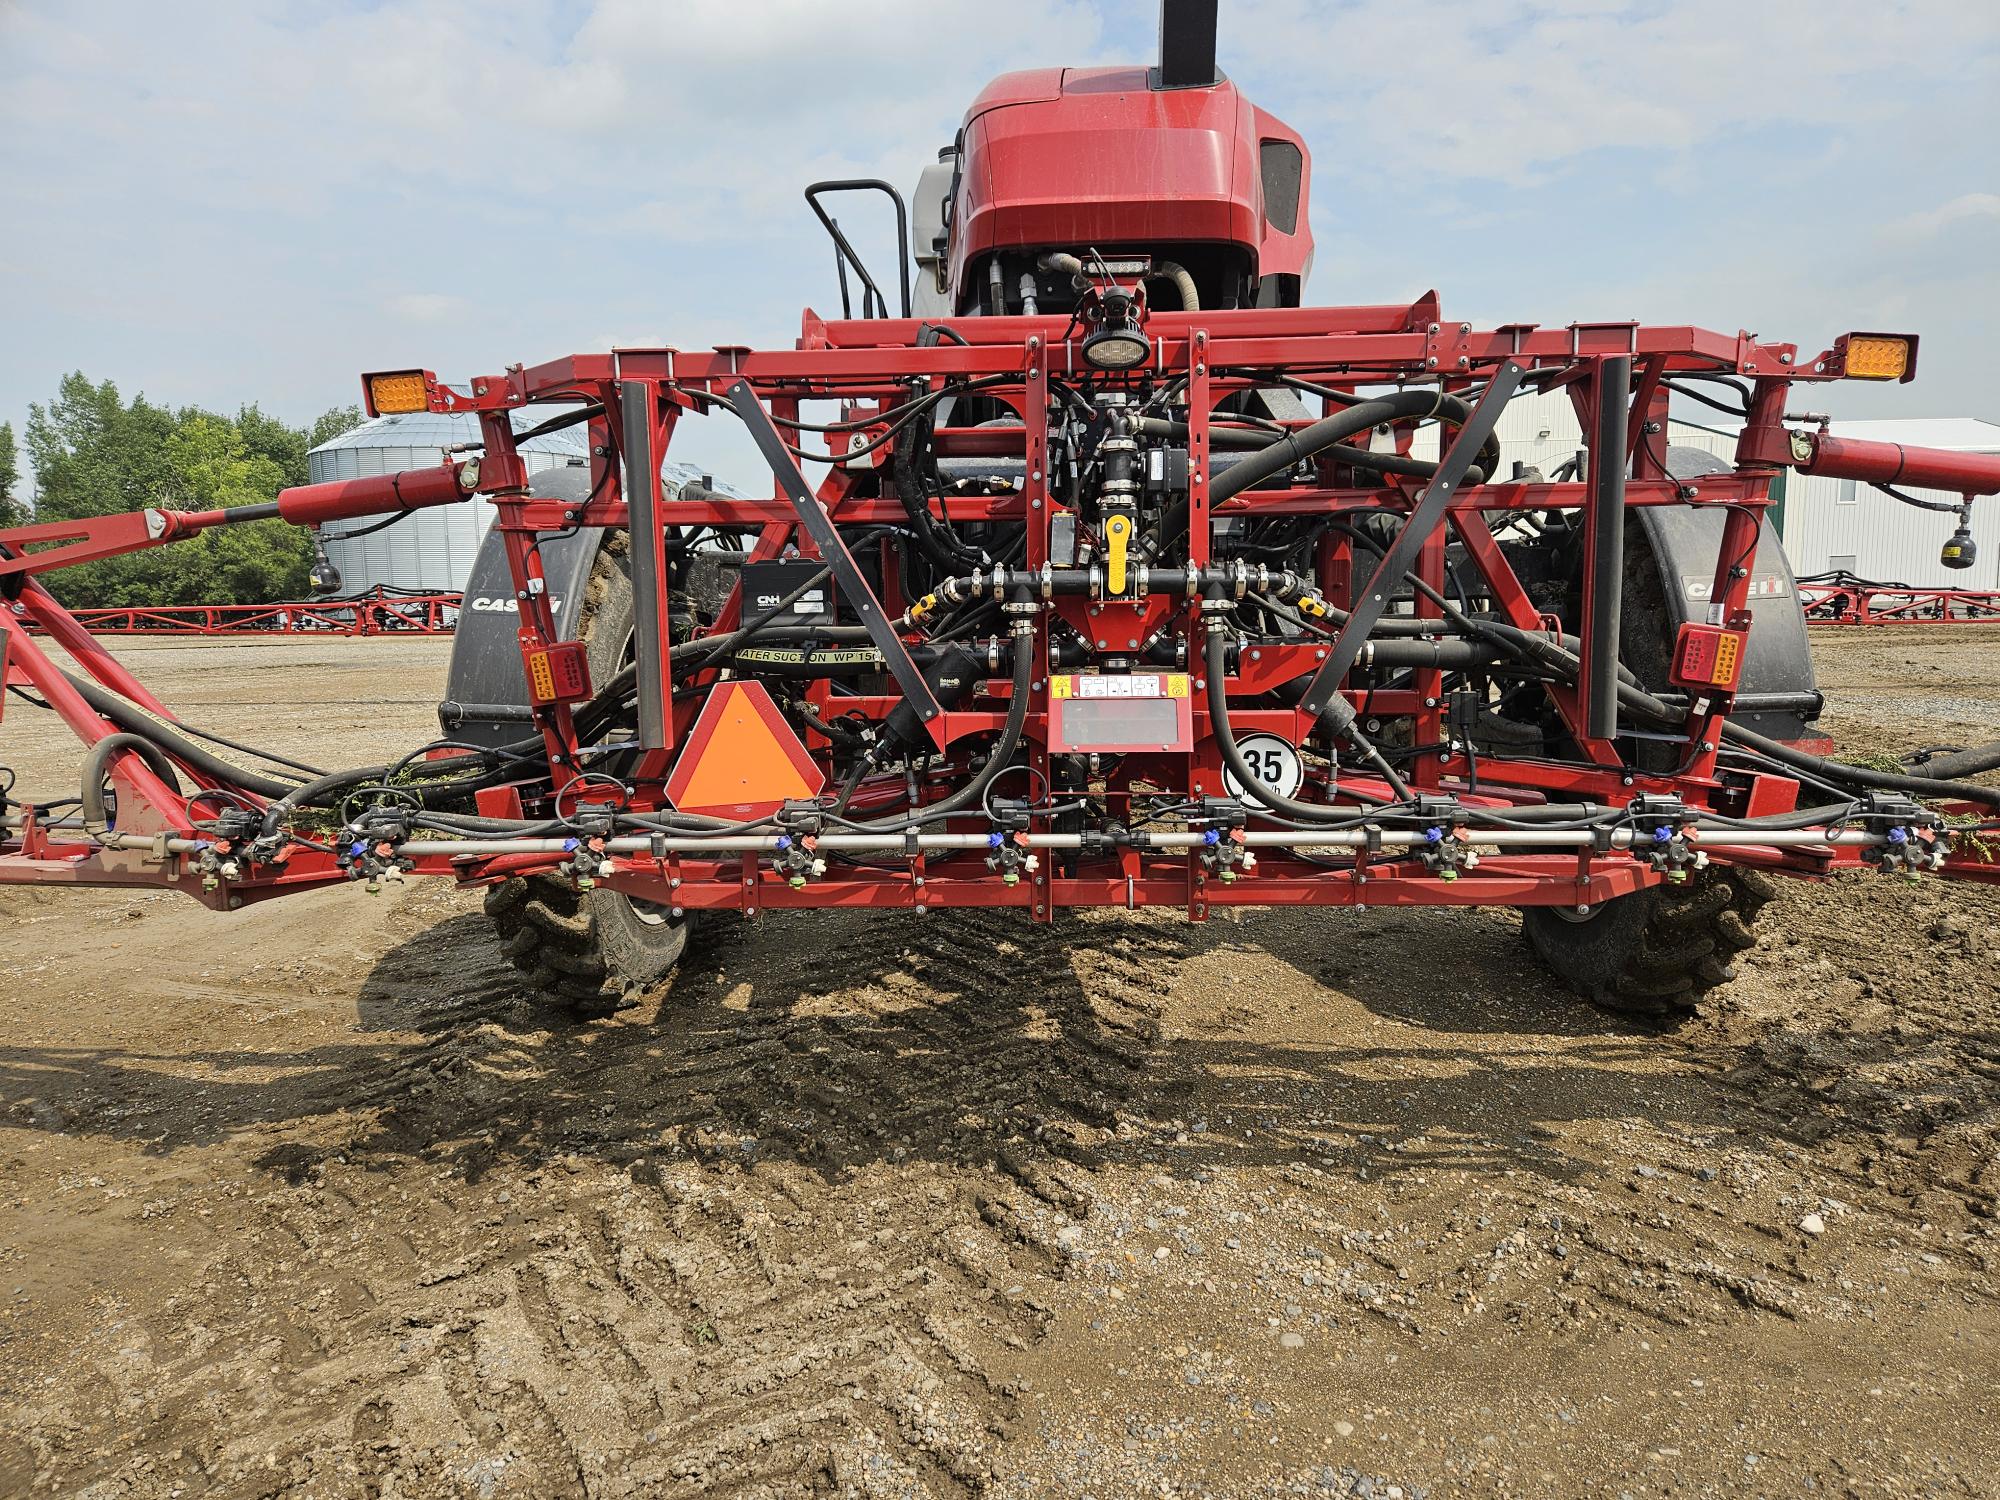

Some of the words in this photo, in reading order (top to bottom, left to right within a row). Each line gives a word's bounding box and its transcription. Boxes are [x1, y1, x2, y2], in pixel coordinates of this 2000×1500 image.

[472, 597, 520, 612] CAS
[757, 595, 780, 603] CNH
[773, 651, 827, 663] SUCTON
[834, 653, 853, 662] WP
[1243, 750, 1282, 782] 35
